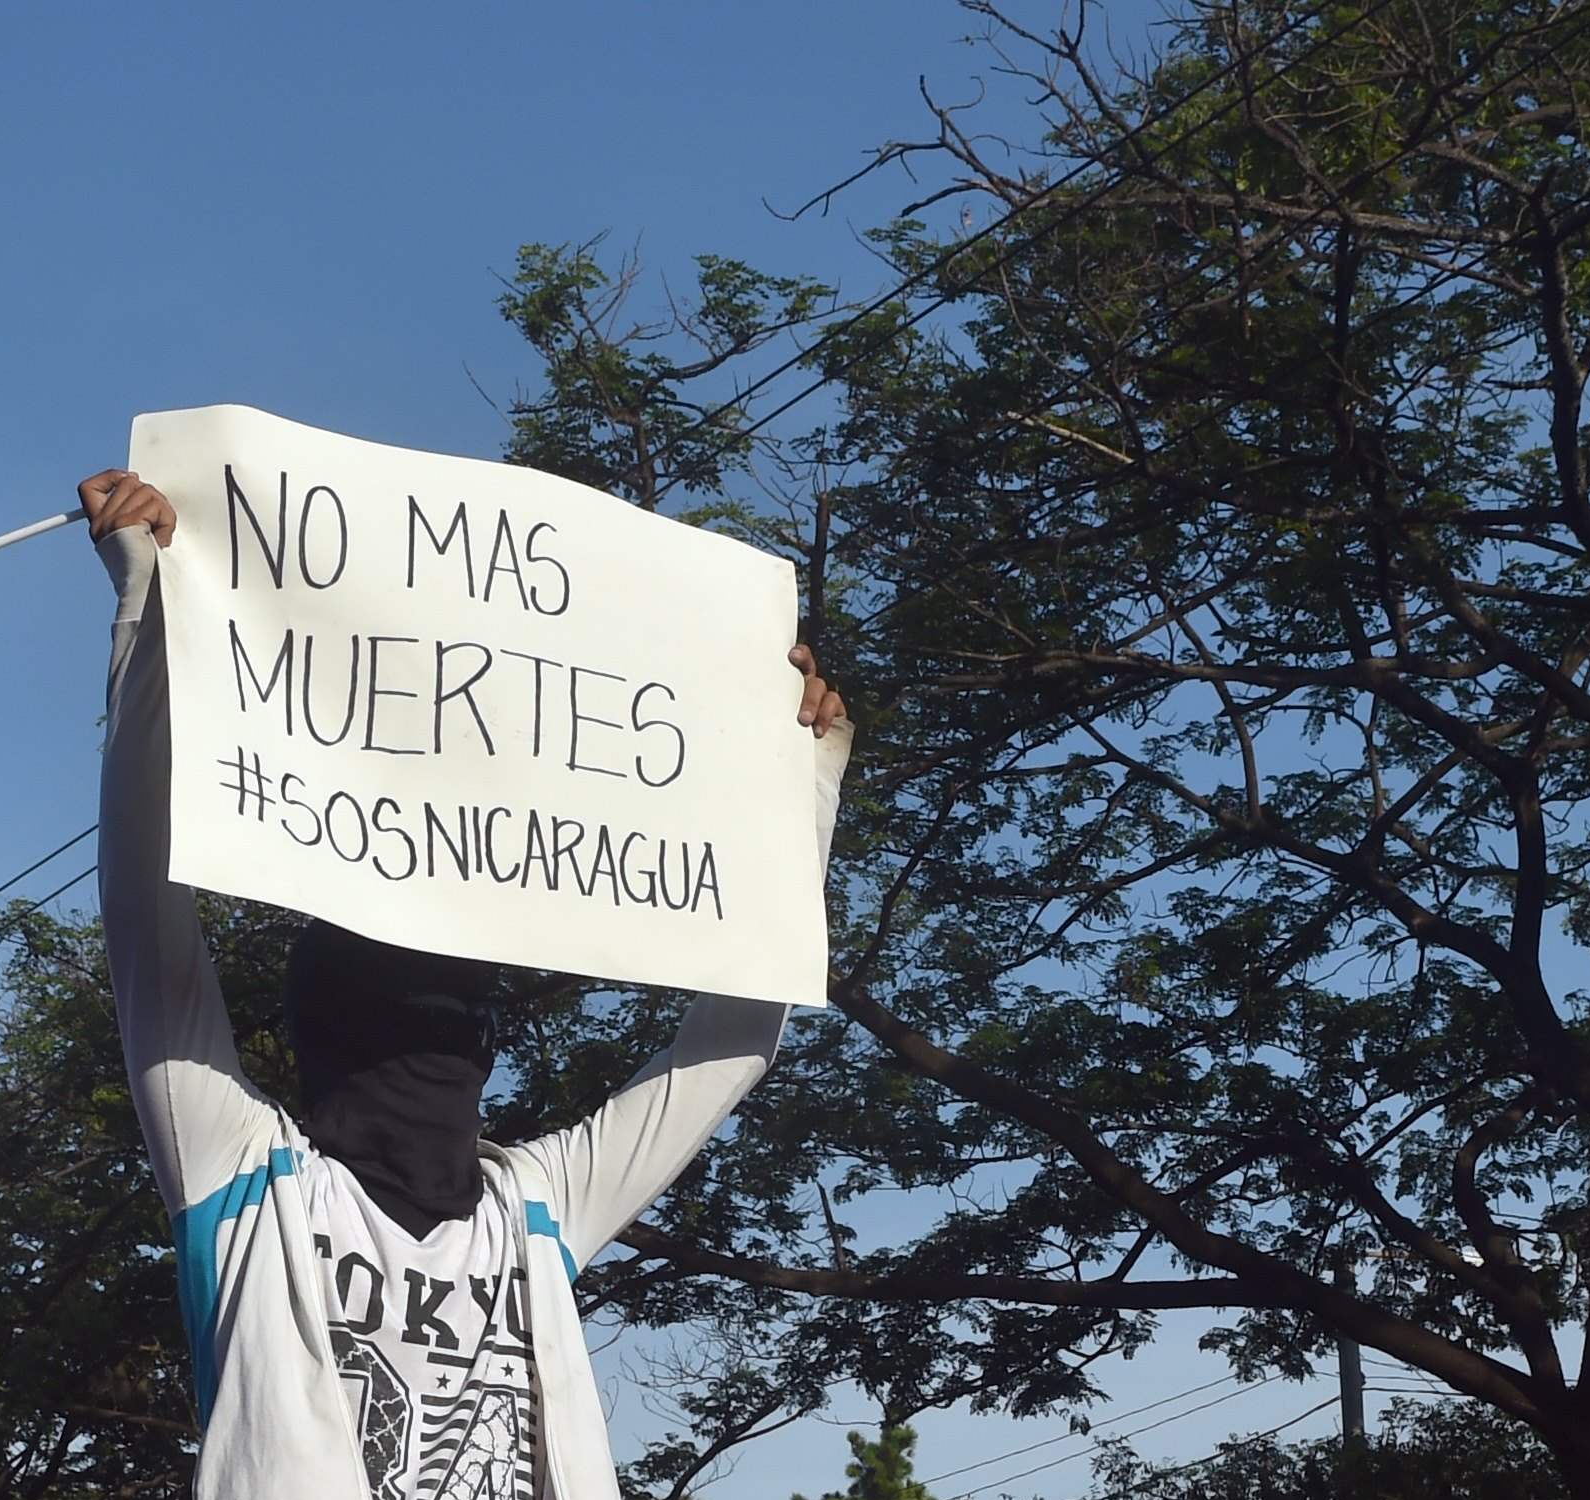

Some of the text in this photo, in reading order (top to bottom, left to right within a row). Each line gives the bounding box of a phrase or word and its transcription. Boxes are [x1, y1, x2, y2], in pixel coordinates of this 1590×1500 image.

[224, 464, 570, 617] NO MAS
[229, 619, 686, 788] MUERTES
[217, 746, 723, 920] #SOSNICARAGUA
